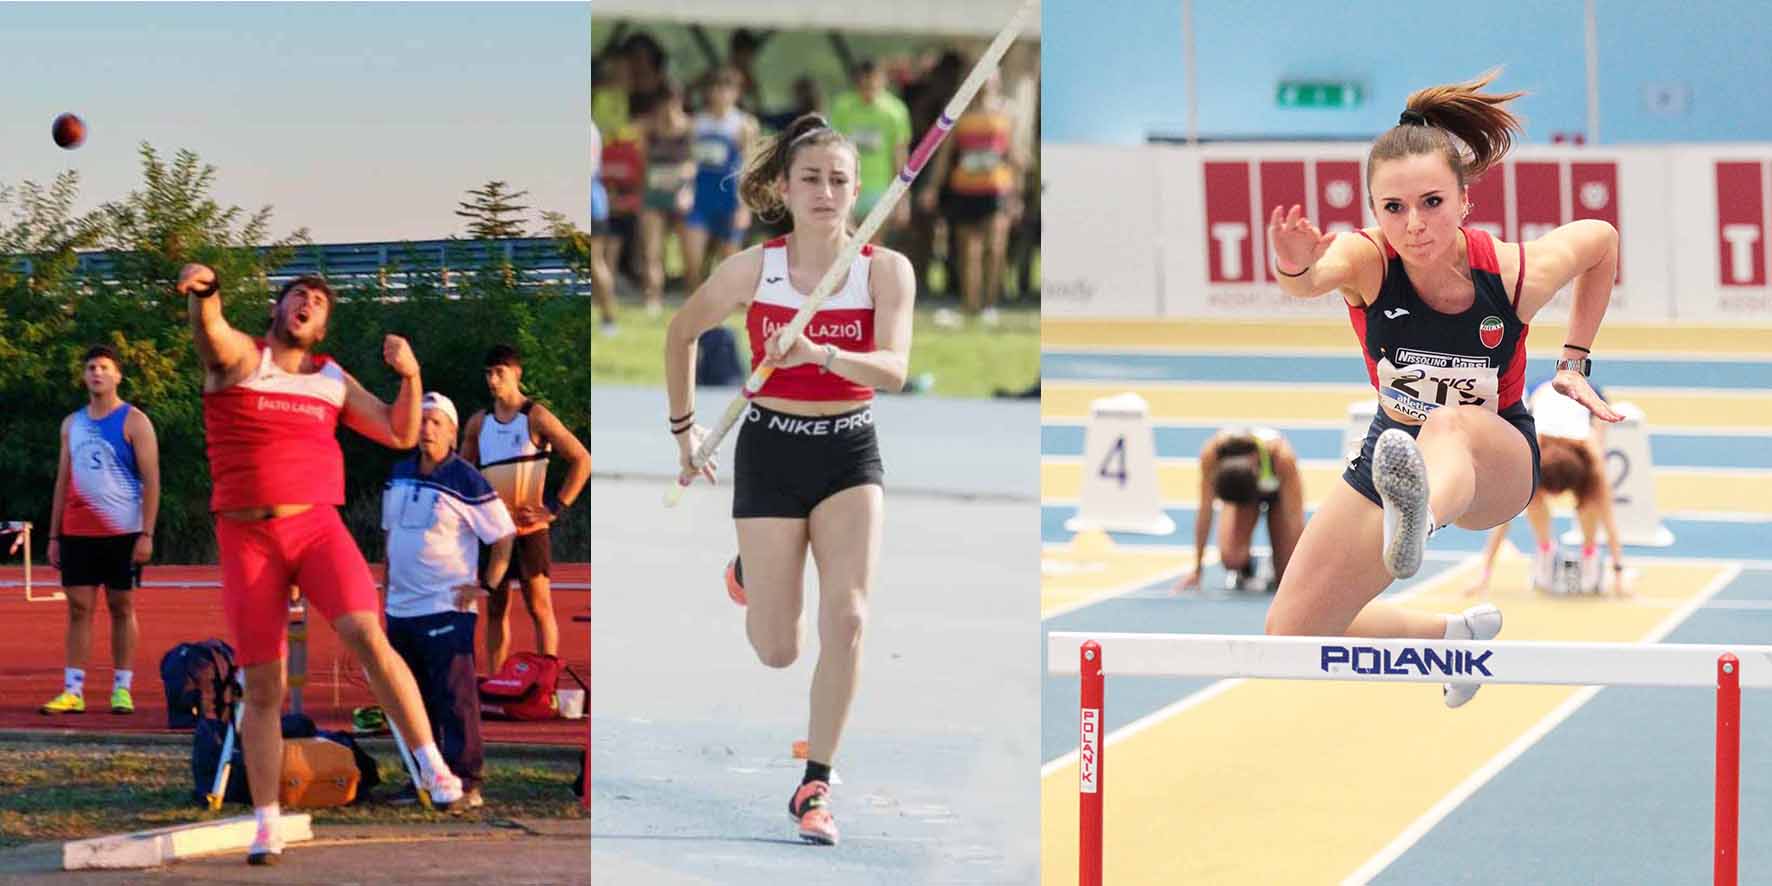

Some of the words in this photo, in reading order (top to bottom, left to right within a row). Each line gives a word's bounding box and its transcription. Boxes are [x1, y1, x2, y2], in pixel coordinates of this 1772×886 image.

[808, 320, 862, 341] LAZIO]
[768, 415, 831, 436] NIKE
[833, 409, 873, 433] PRO
[1099, 437, 1128, 489] 4
[1605, 449, 1632, 504] 2
[1320, 645, 1494, 677] POLANIK
[1082, 711, 1095, 783] POLANIK
